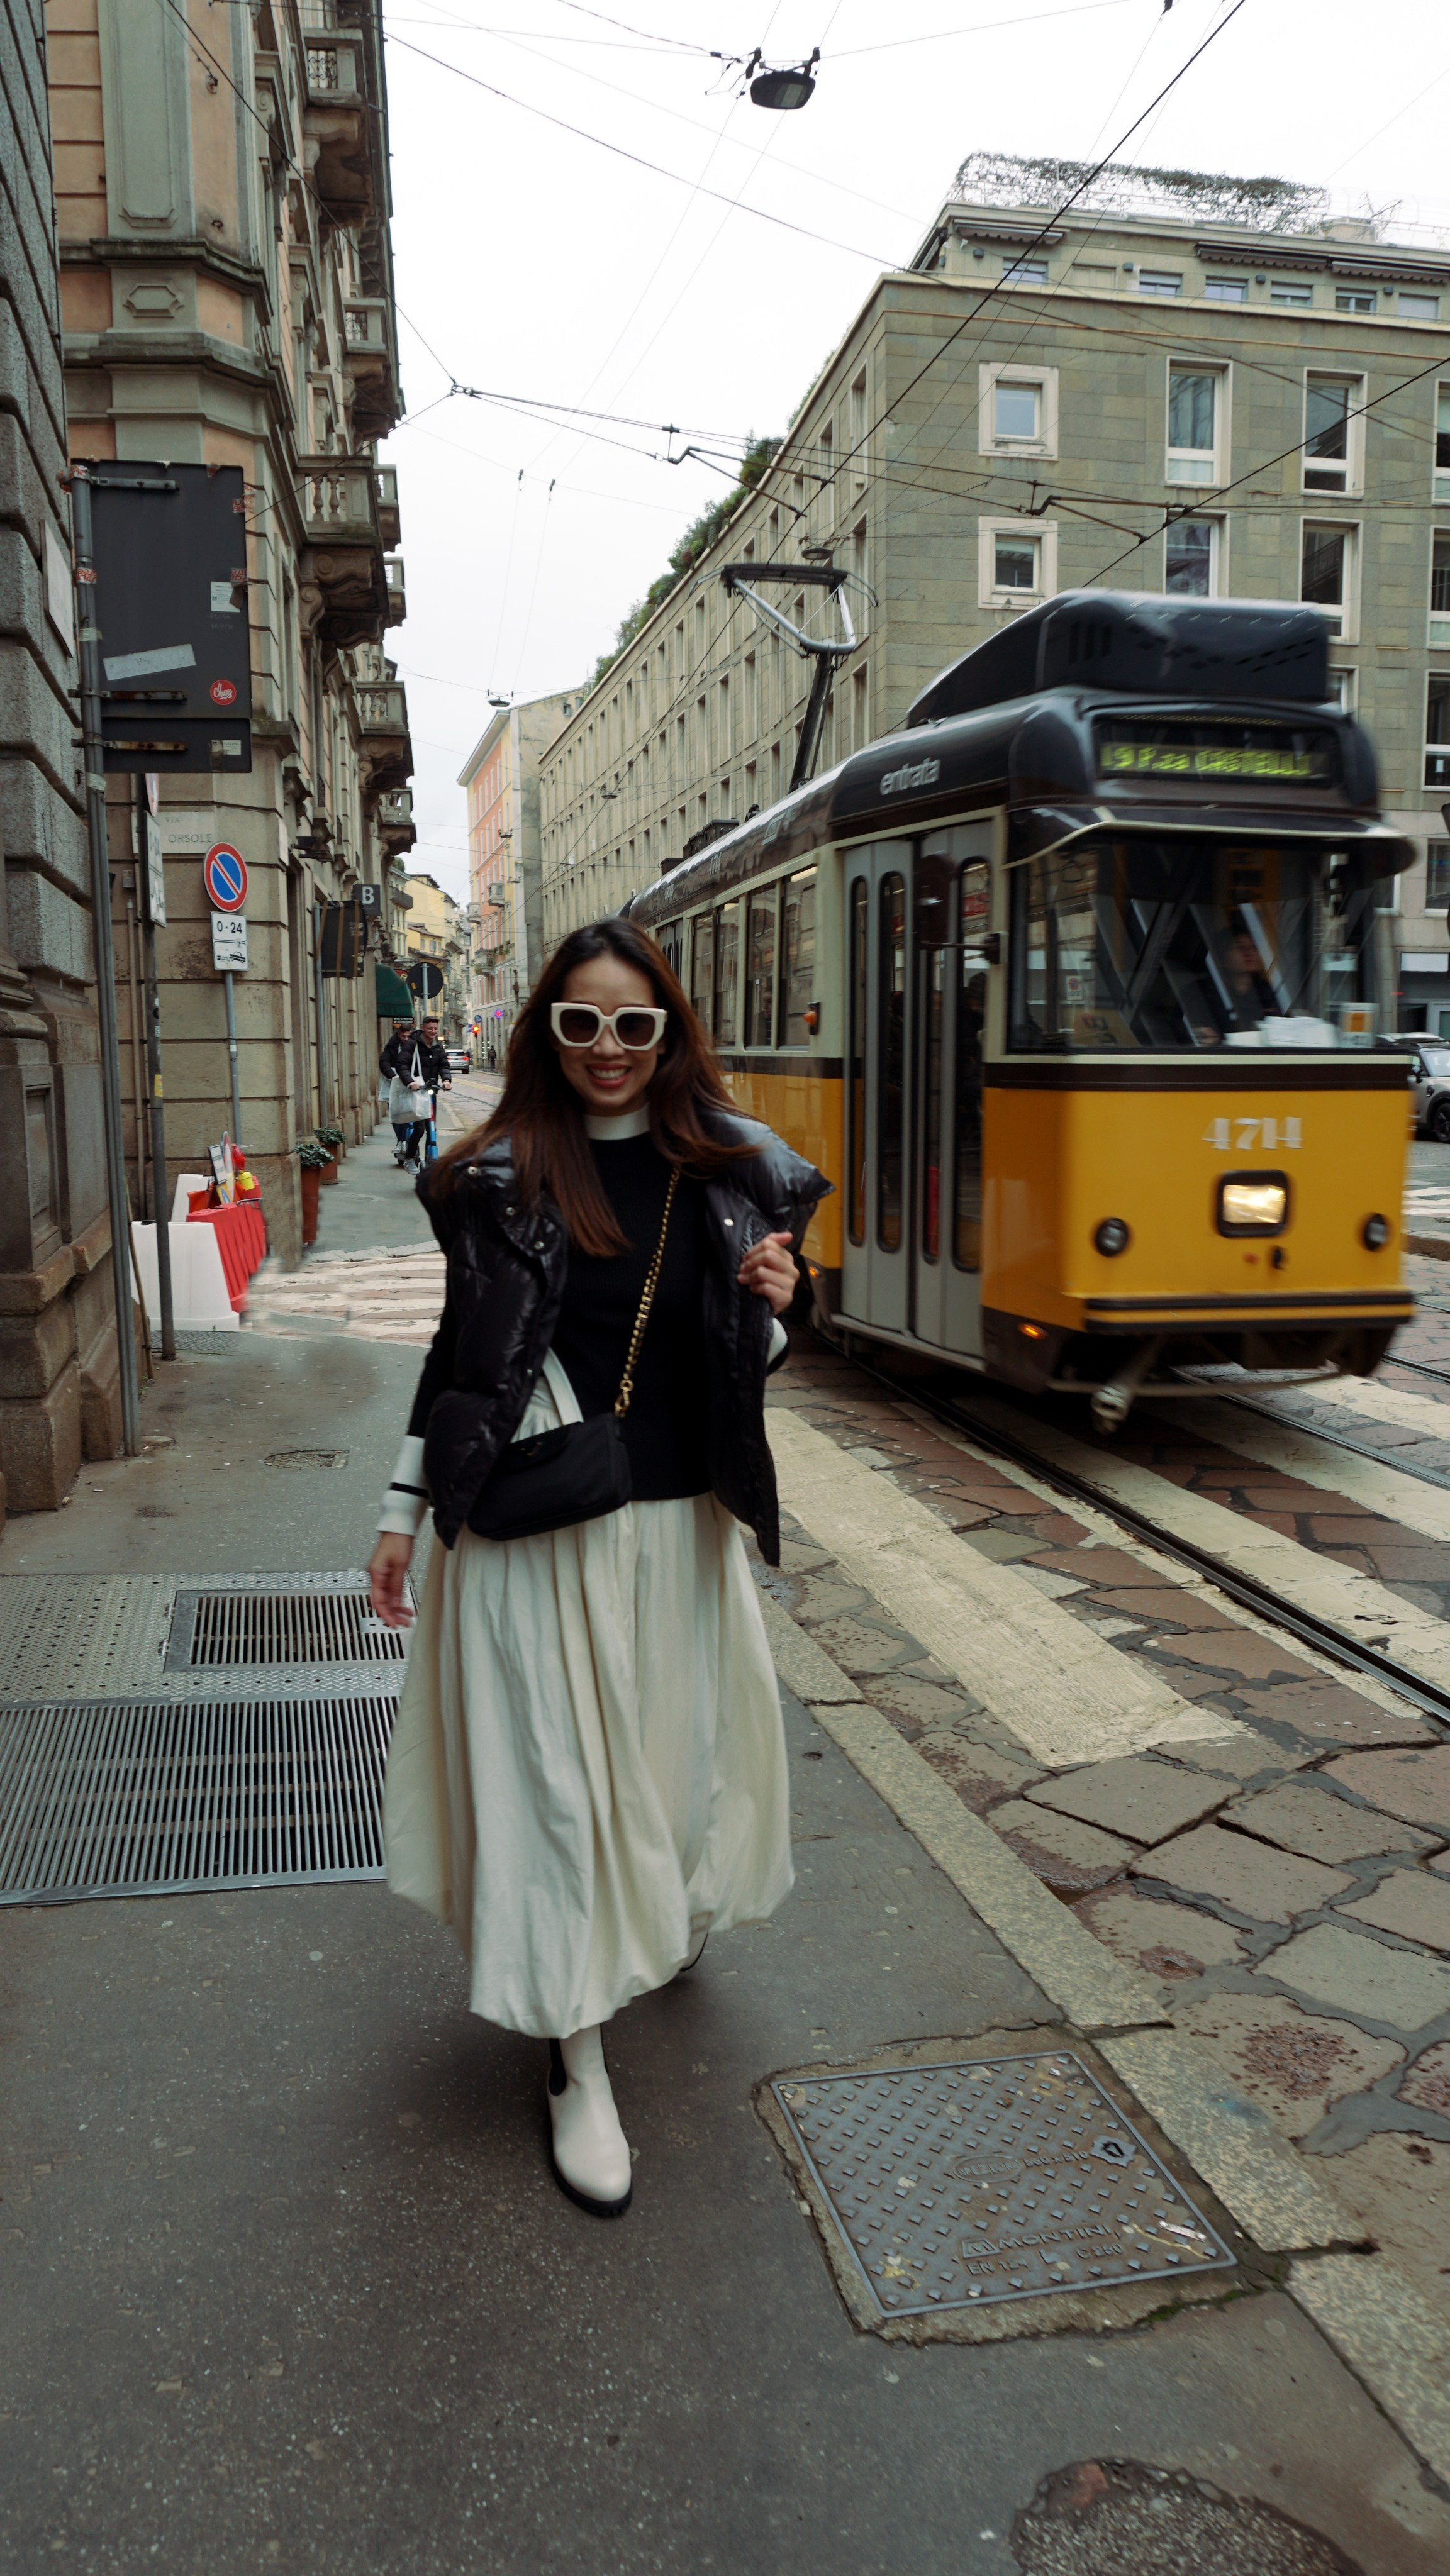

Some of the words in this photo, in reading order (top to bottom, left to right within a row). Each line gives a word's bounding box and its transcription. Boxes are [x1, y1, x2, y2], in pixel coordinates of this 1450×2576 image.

[1101, 745, 1135, 767] 19
[879, 757, 941, 796] entrata
[168, 833, 213, 843] ORSOLE
[362, 886, 374, 904] B
[230, 921, 242, 933] 24
[1201, 1116, 1304, 1150] 4714
[1023, 2157, 1051, 2168] 560
[1063, 2150, 1090, 2163] 510
[998, 2224, 1112, 2250] MONTINI
[966, 2261, 995, 2275] EN
[998, 2258, 1029, 2271] 124
[1076, 2248, 1090, 2260] C
[1091, 2242, 1124, 2258] 250
